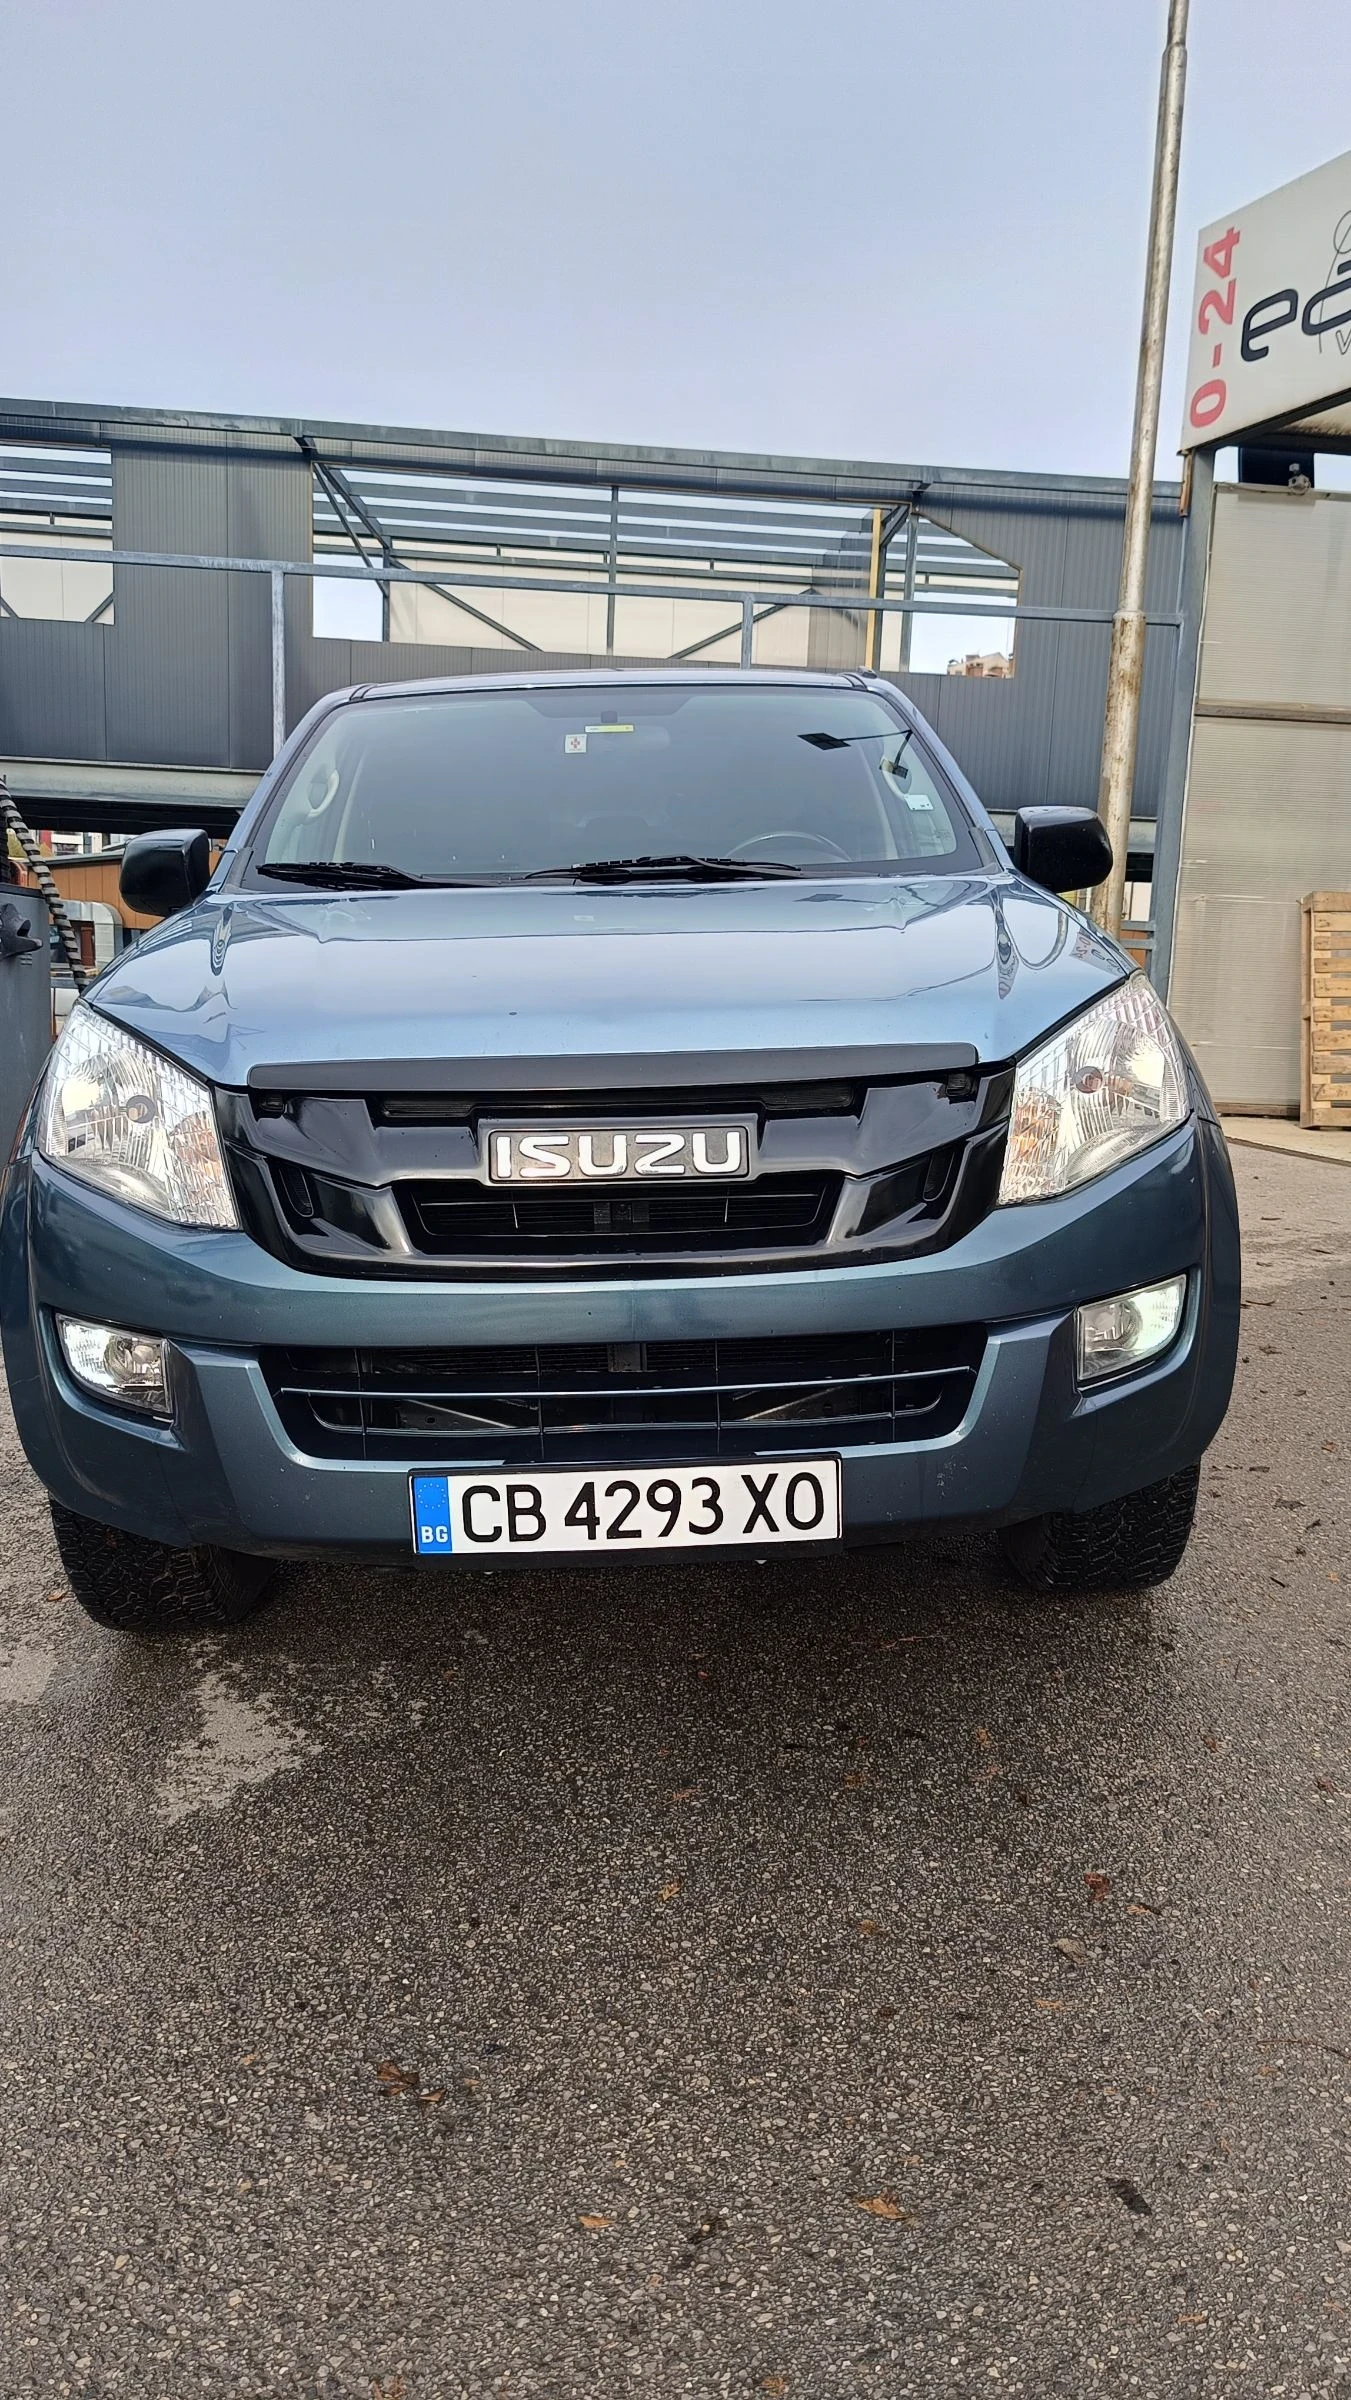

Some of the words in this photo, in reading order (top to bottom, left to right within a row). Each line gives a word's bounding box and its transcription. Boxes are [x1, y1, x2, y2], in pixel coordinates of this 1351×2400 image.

[496, 1131, 741, 1178] ISUZU
[462, 1484, 546, 1543] CB
[564, 1476, 724, 1541] 4293
[741, 1472, 825, 1534] XO
[421, 1526, 448, 1544] BG
